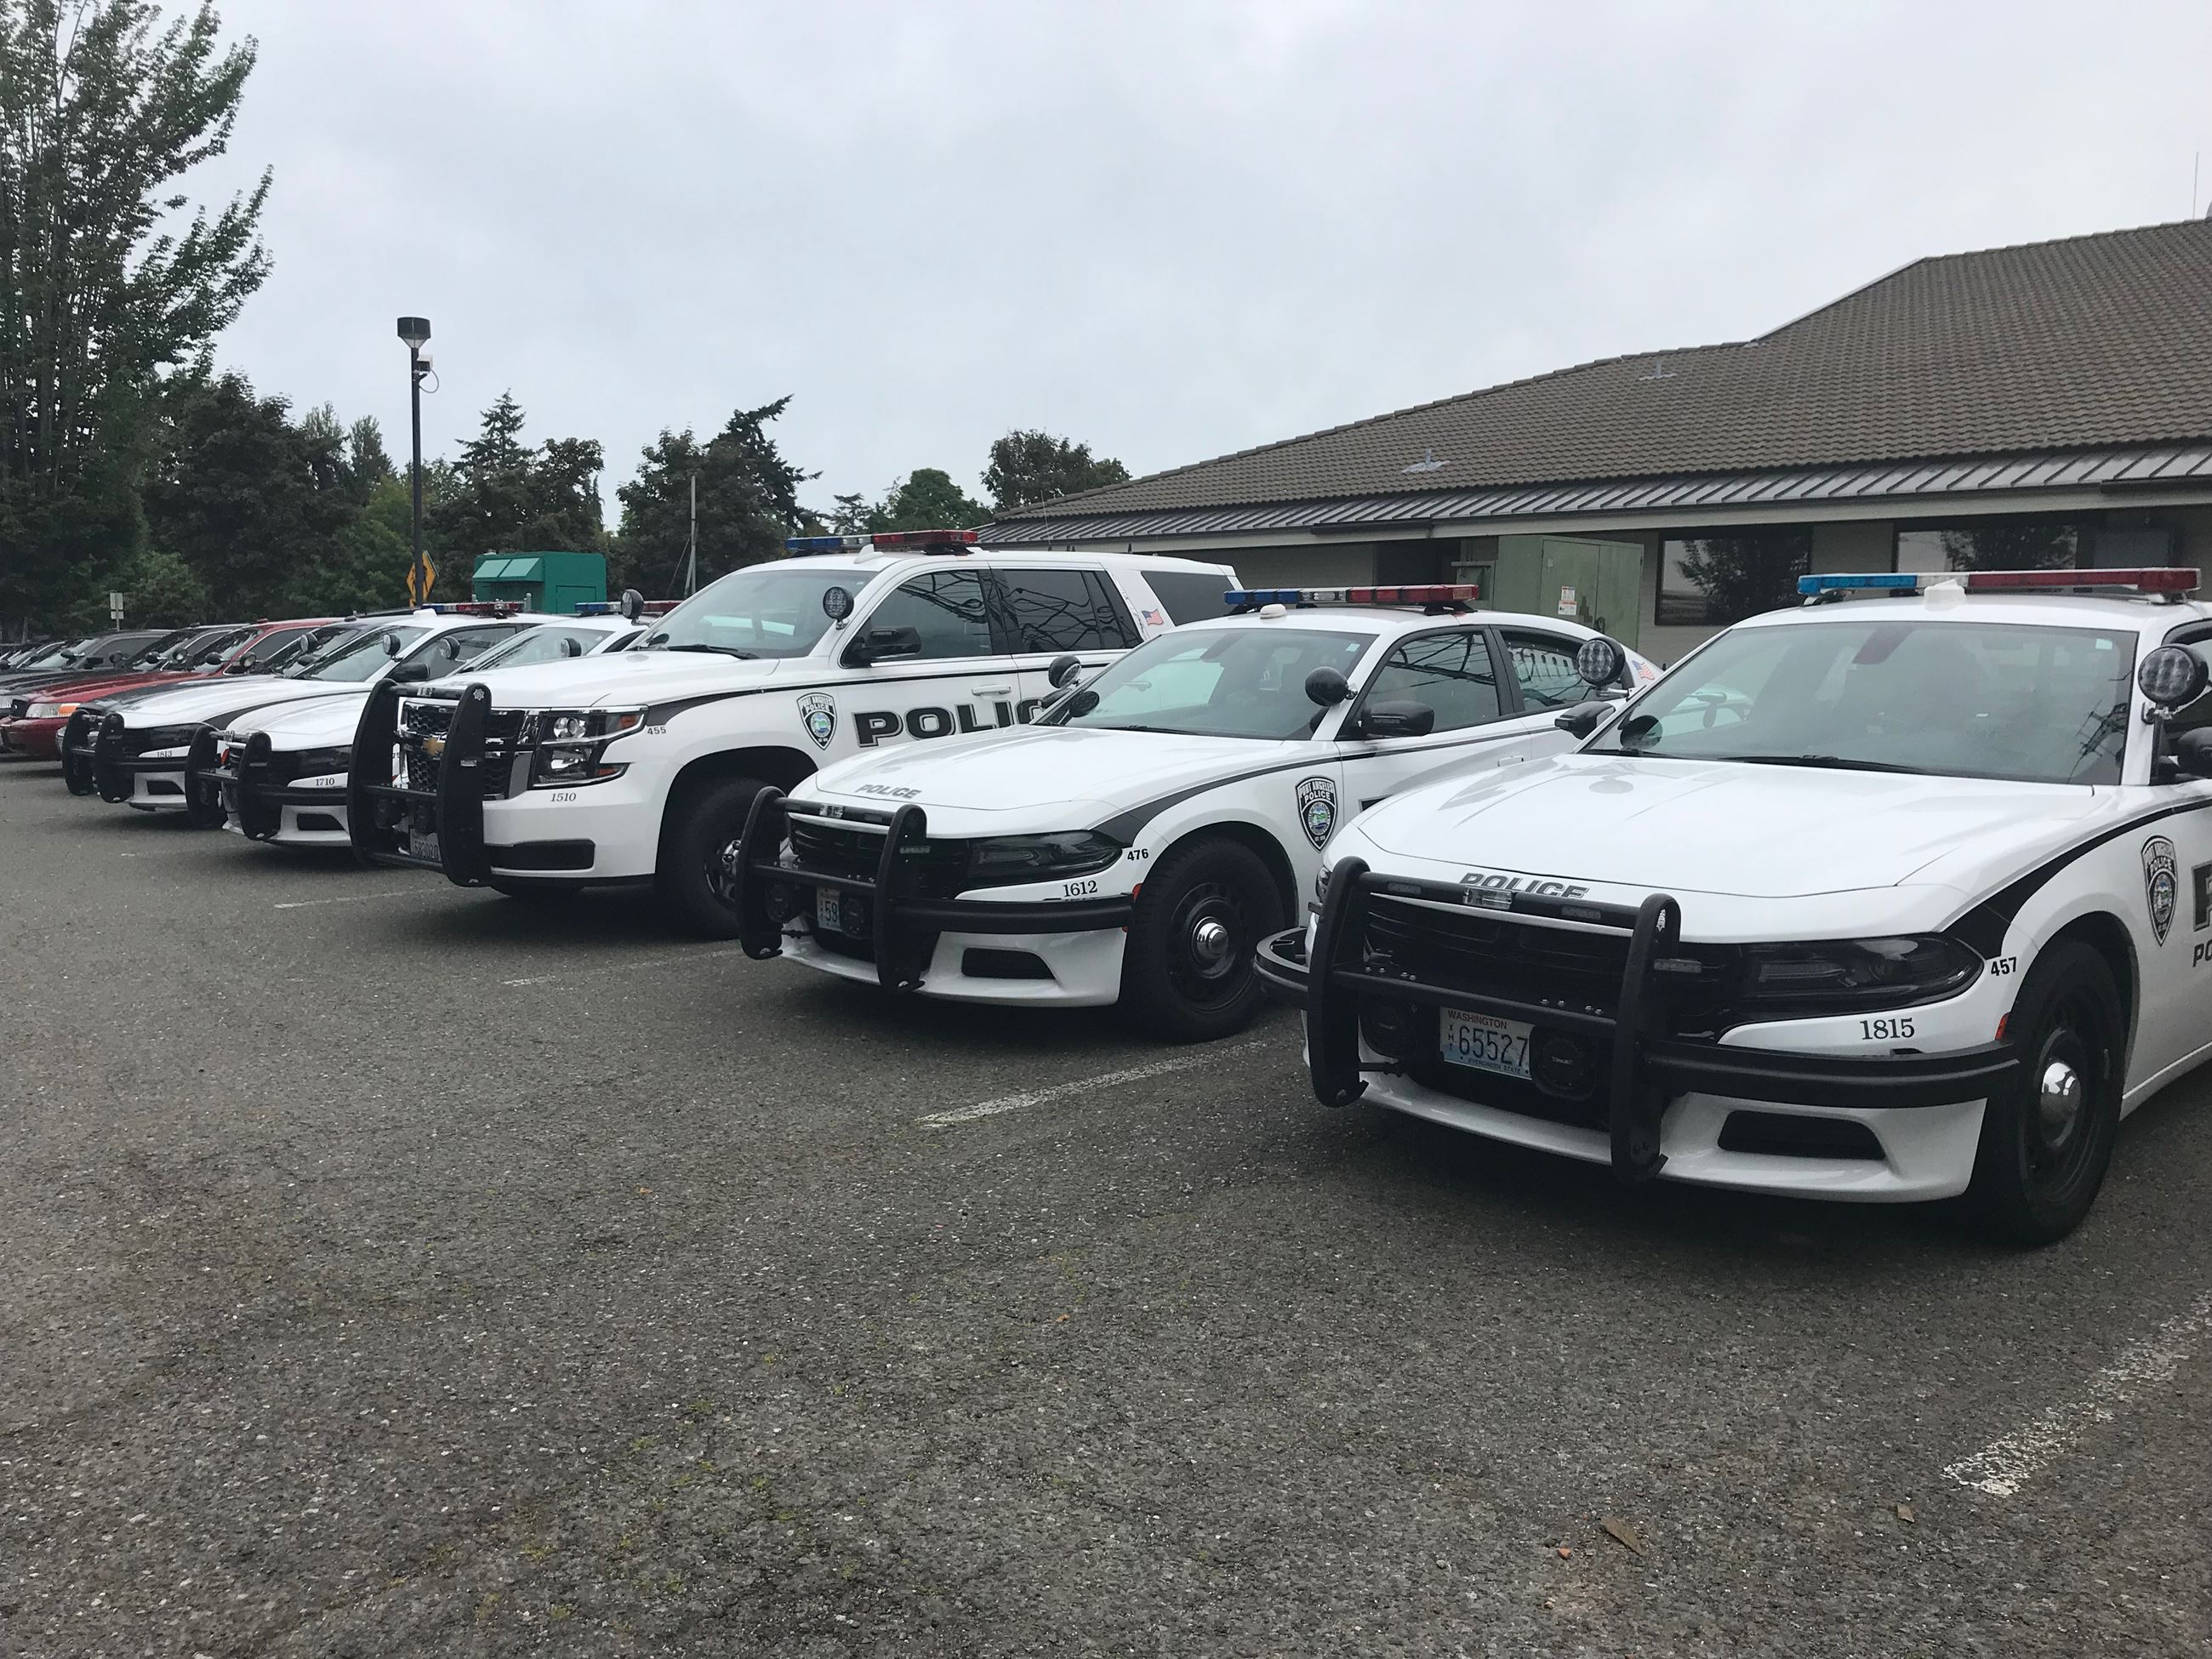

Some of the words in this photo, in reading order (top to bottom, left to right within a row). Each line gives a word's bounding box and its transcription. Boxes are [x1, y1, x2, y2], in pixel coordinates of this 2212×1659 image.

[647, 727, 667, 735] 455
[316, 778, 335, 786] 1710
[551, 792, 577, 802] 1510
[854, 784, 922, 799] POLICE
[1303, 790, 1332, 804] POLICE
[1127, 848, 1149, 861] 476
[2148, 856, 2173, 877] POLICE
[1063, 880, 1098, 897] 1612
[1459, 872, 1591, 899] POLICE
[1991, 956, 2016, 976] 457
[1448, 1009, 1508, 1029] WASHINGTON
[1860, 1018, 1915, 1040] 1815
[1459, 1025, 1529, 1067] 65527
